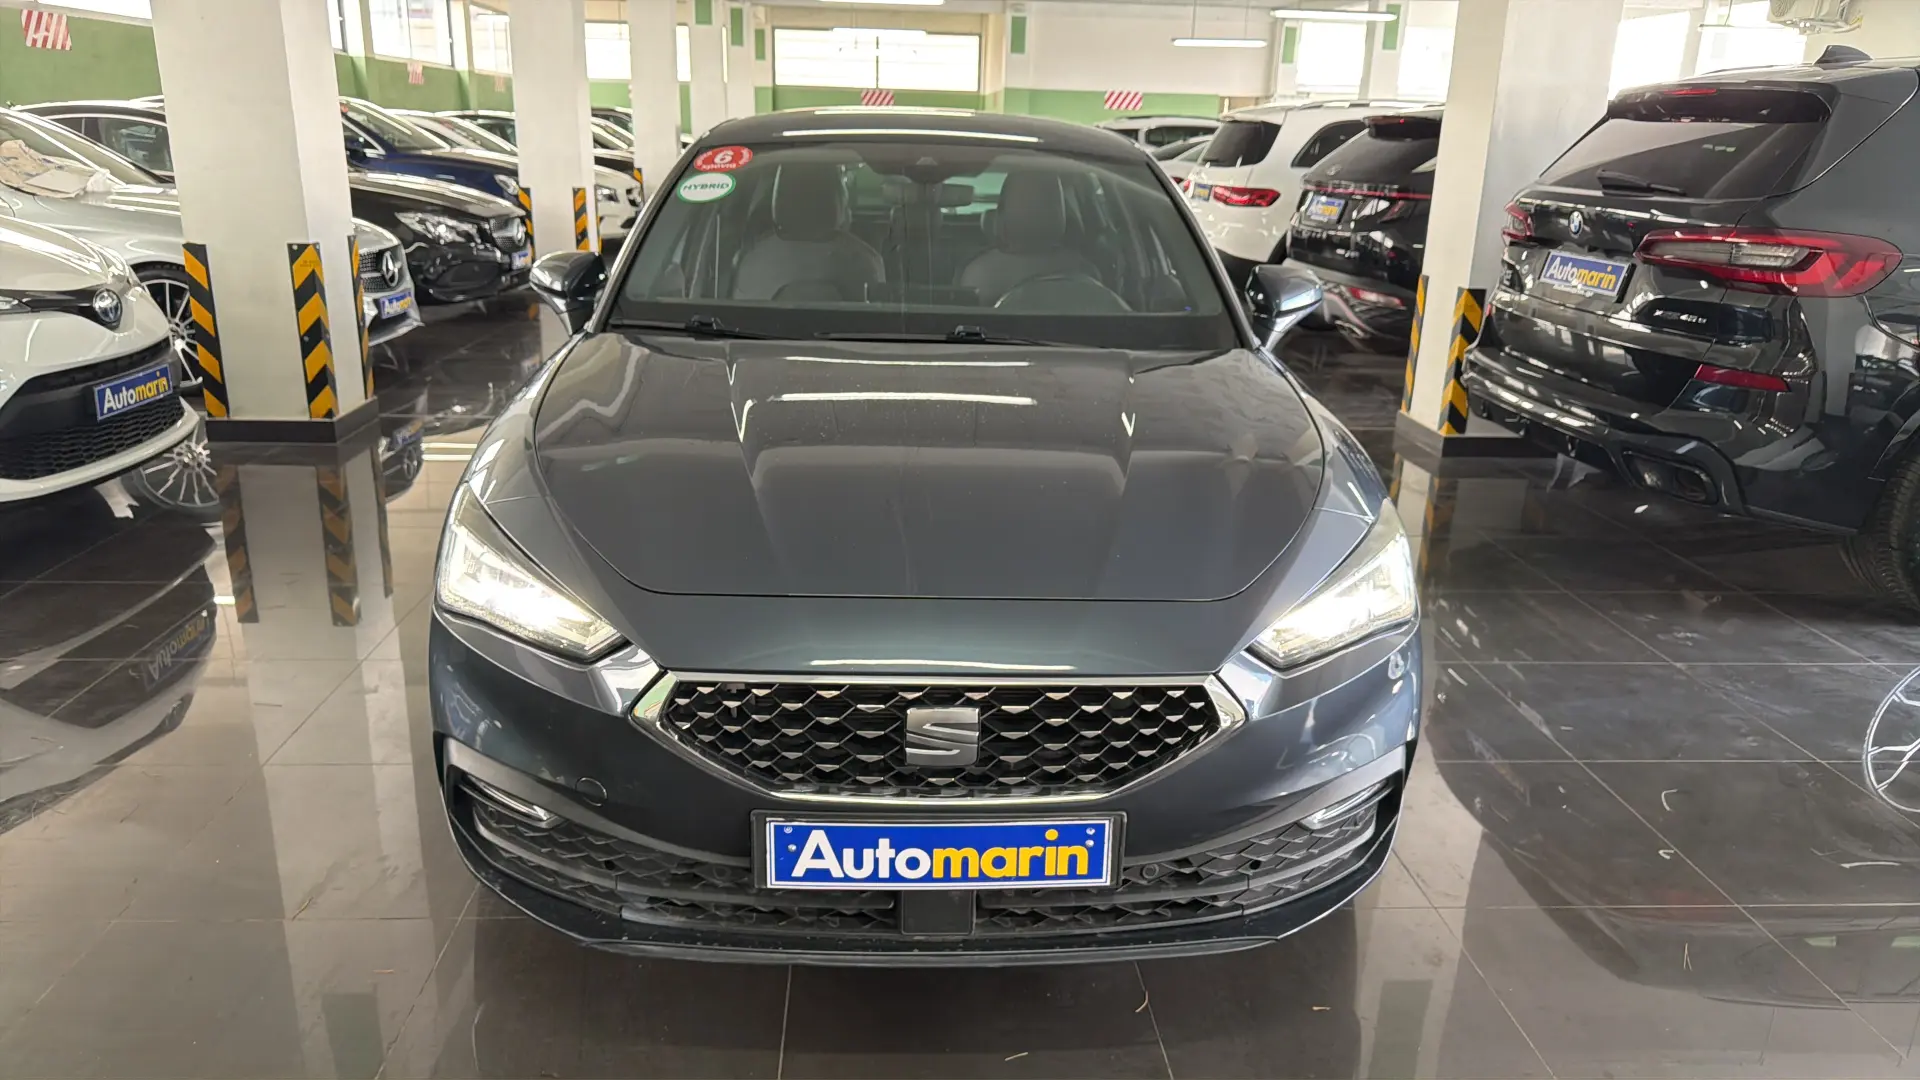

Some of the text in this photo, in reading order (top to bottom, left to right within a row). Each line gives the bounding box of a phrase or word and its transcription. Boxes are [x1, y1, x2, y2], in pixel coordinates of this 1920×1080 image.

[714, 150, 734, 164] 6
[683, 182, 730, 192] HYBRID
[1546, 256, 1617, 290] Automarin
[103, 370, 169, 414] Automarin
[791, 828, 1089, 879] Automarin
